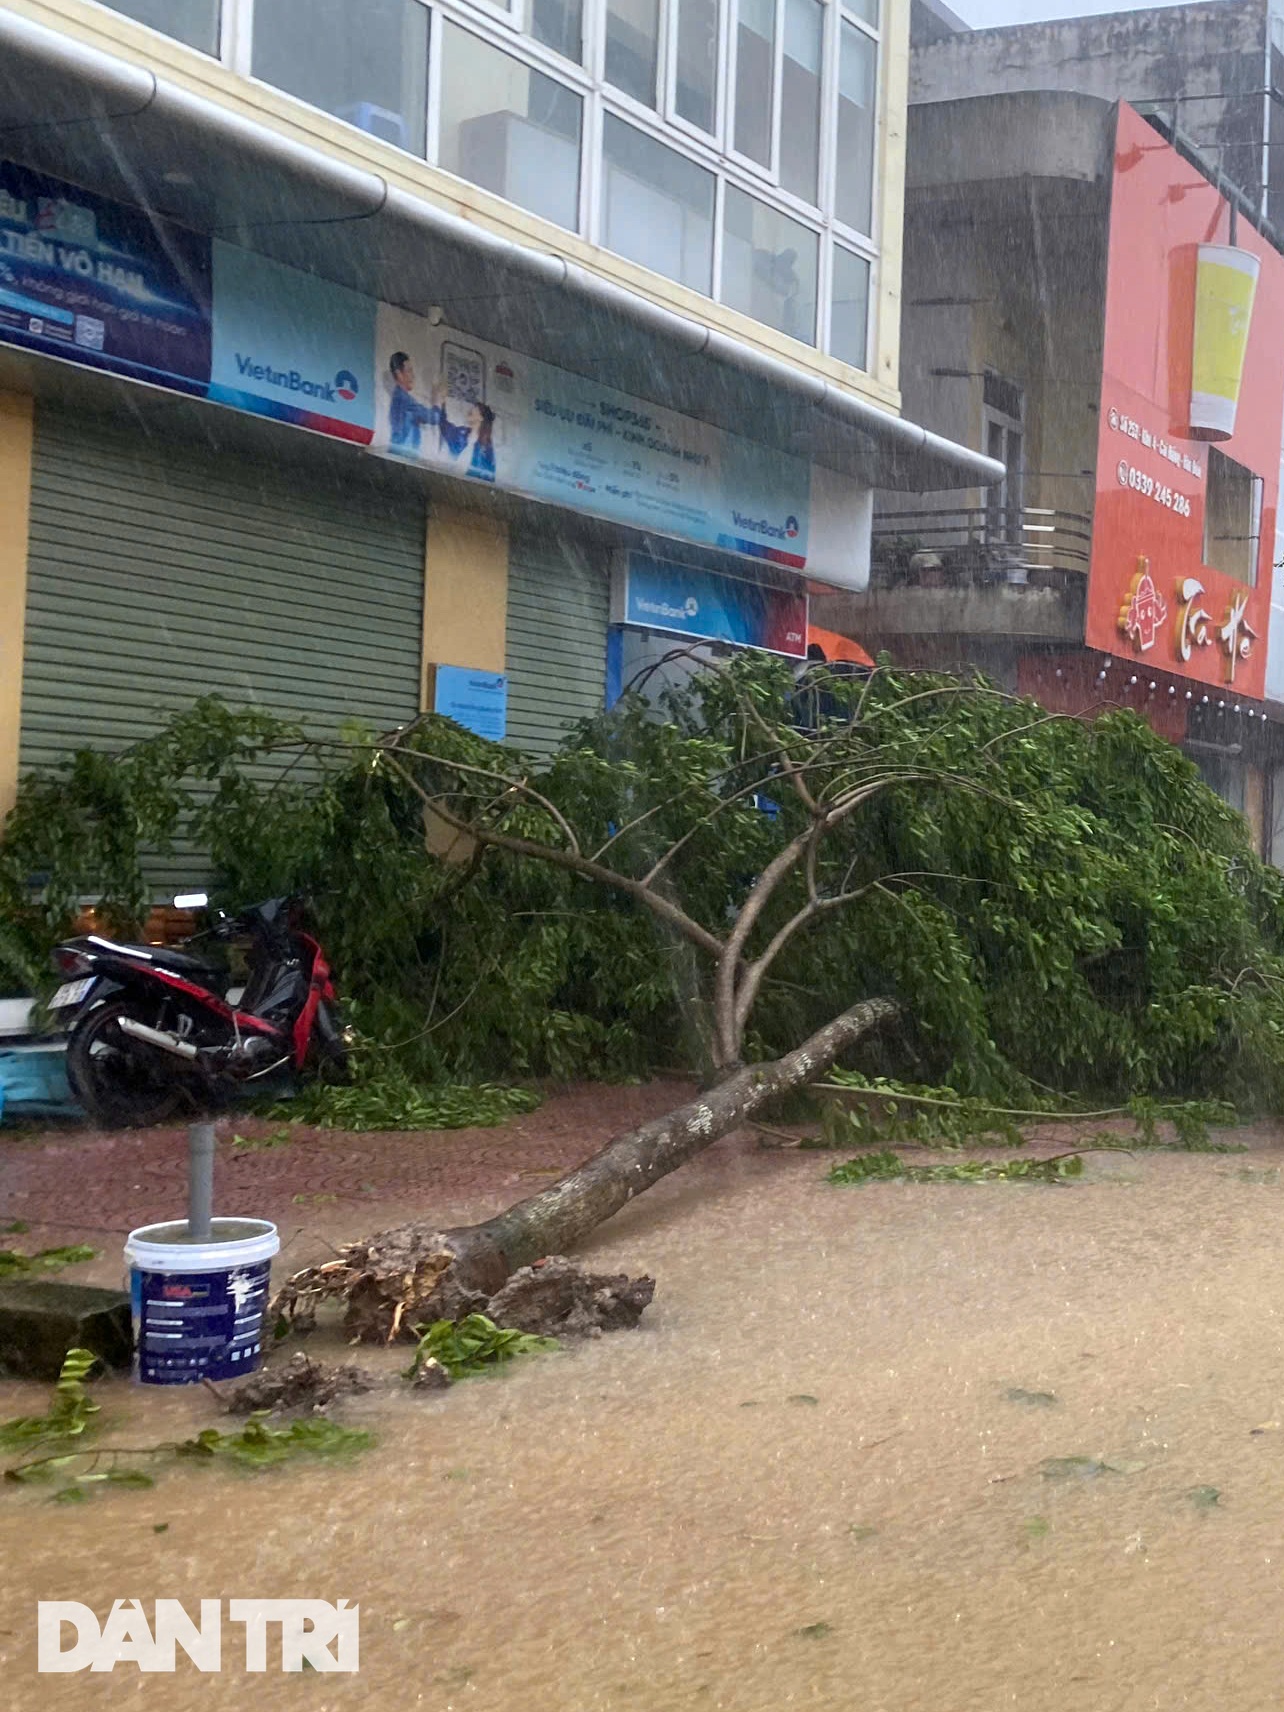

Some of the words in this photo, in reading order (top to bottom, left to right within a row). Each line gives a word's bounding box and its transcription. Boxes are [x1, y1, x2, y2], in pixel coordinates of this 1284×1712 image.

[234, 352, 337, 403] VietinBank
[1128, 467, 1154, 497] 0339
[1154, 481, 1173, 508] 245
[785, 630, 802, 645] ATM
